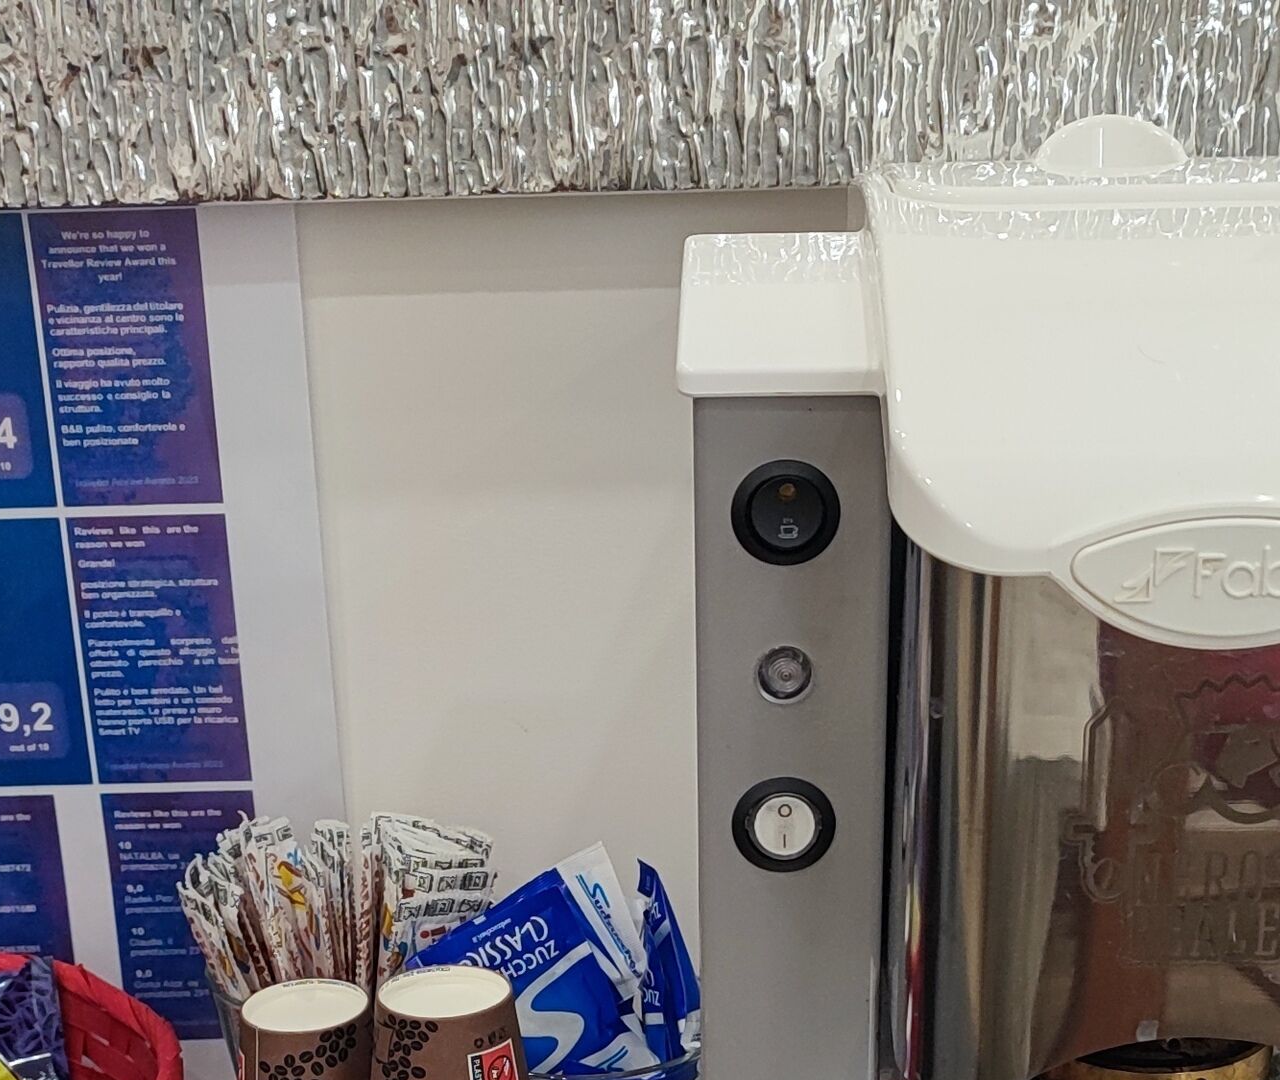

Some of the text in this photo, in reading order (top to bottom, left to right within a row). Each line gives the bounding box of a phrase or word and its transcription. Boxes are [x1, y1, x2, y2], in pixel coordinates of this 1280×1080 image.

[91, 230, 104, 240] so
[106, 229, 137, 242] happy
[138, 227, 151, 239] to
[124, 256, 156, 268] Award
[0, 461, 12, 471] 10
[502, 938, 560, 979] ZUCCH
